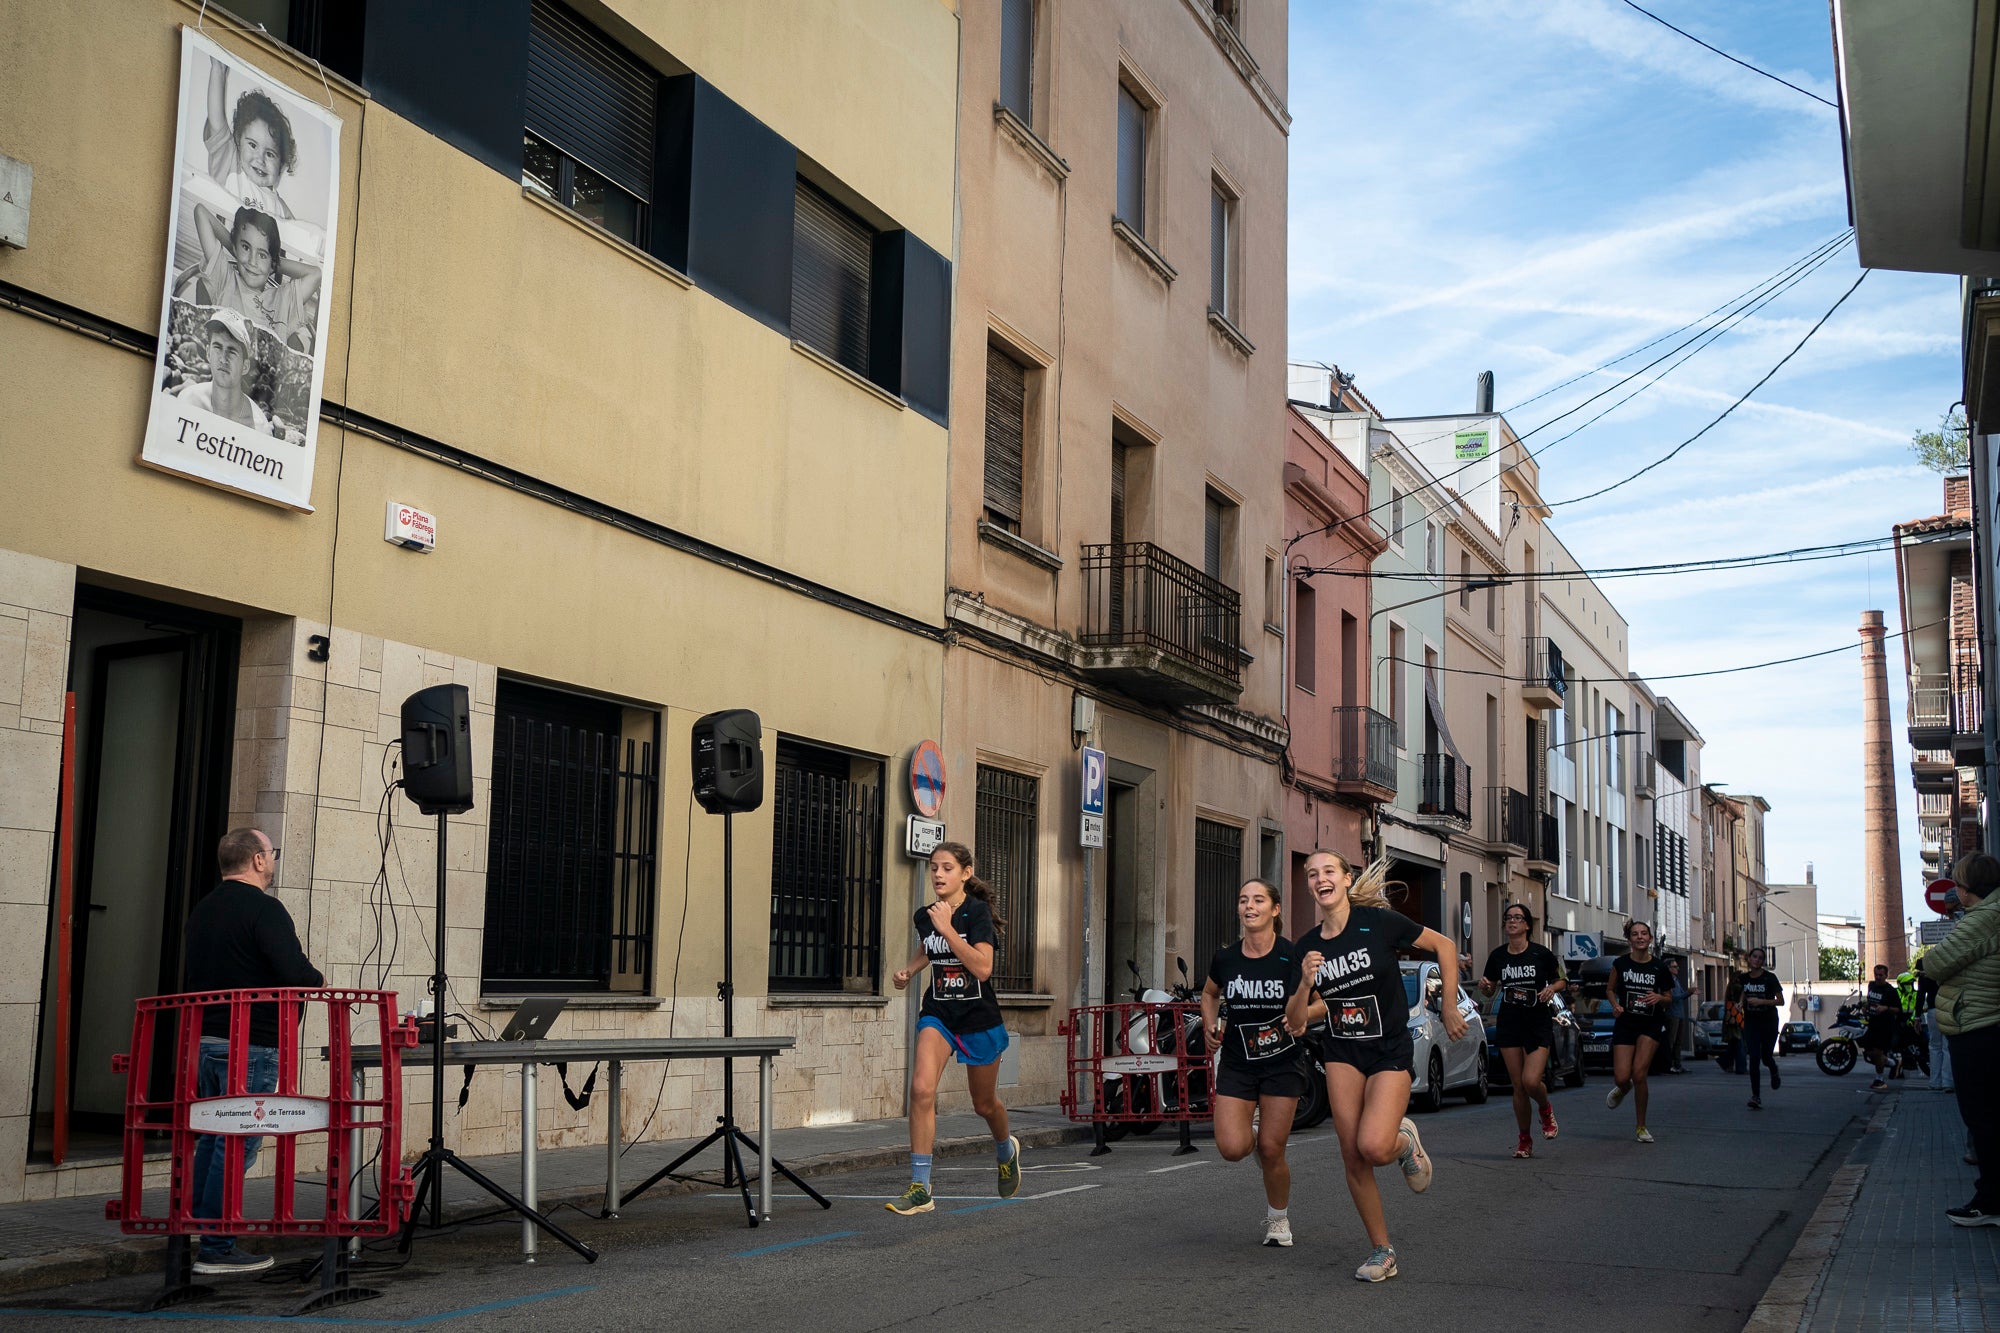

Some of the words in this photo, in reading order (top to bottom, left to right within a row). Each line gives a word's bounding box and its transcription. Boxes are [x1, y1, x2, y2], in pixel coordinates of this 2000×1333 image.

[177, 416, 284, 480] T'estimem
[400, 511, 411, 523] PF
[412, 511, 429, 524] Plana
[308, 634, 330, 663] 3
[1086, 755, 1101, 806] P
[943, 977, 965, 988] 780
[1338, 982, 1350, 991] PAU
[1341, 1013, 1364, 1024] 464
[1257, 1032, 1279, 1046] 663
[214, 1109, 252, 1119] Ajuntament
[268, 1108, 277, 1116] de
[278, 1108, 306, 1116] Terrassa
